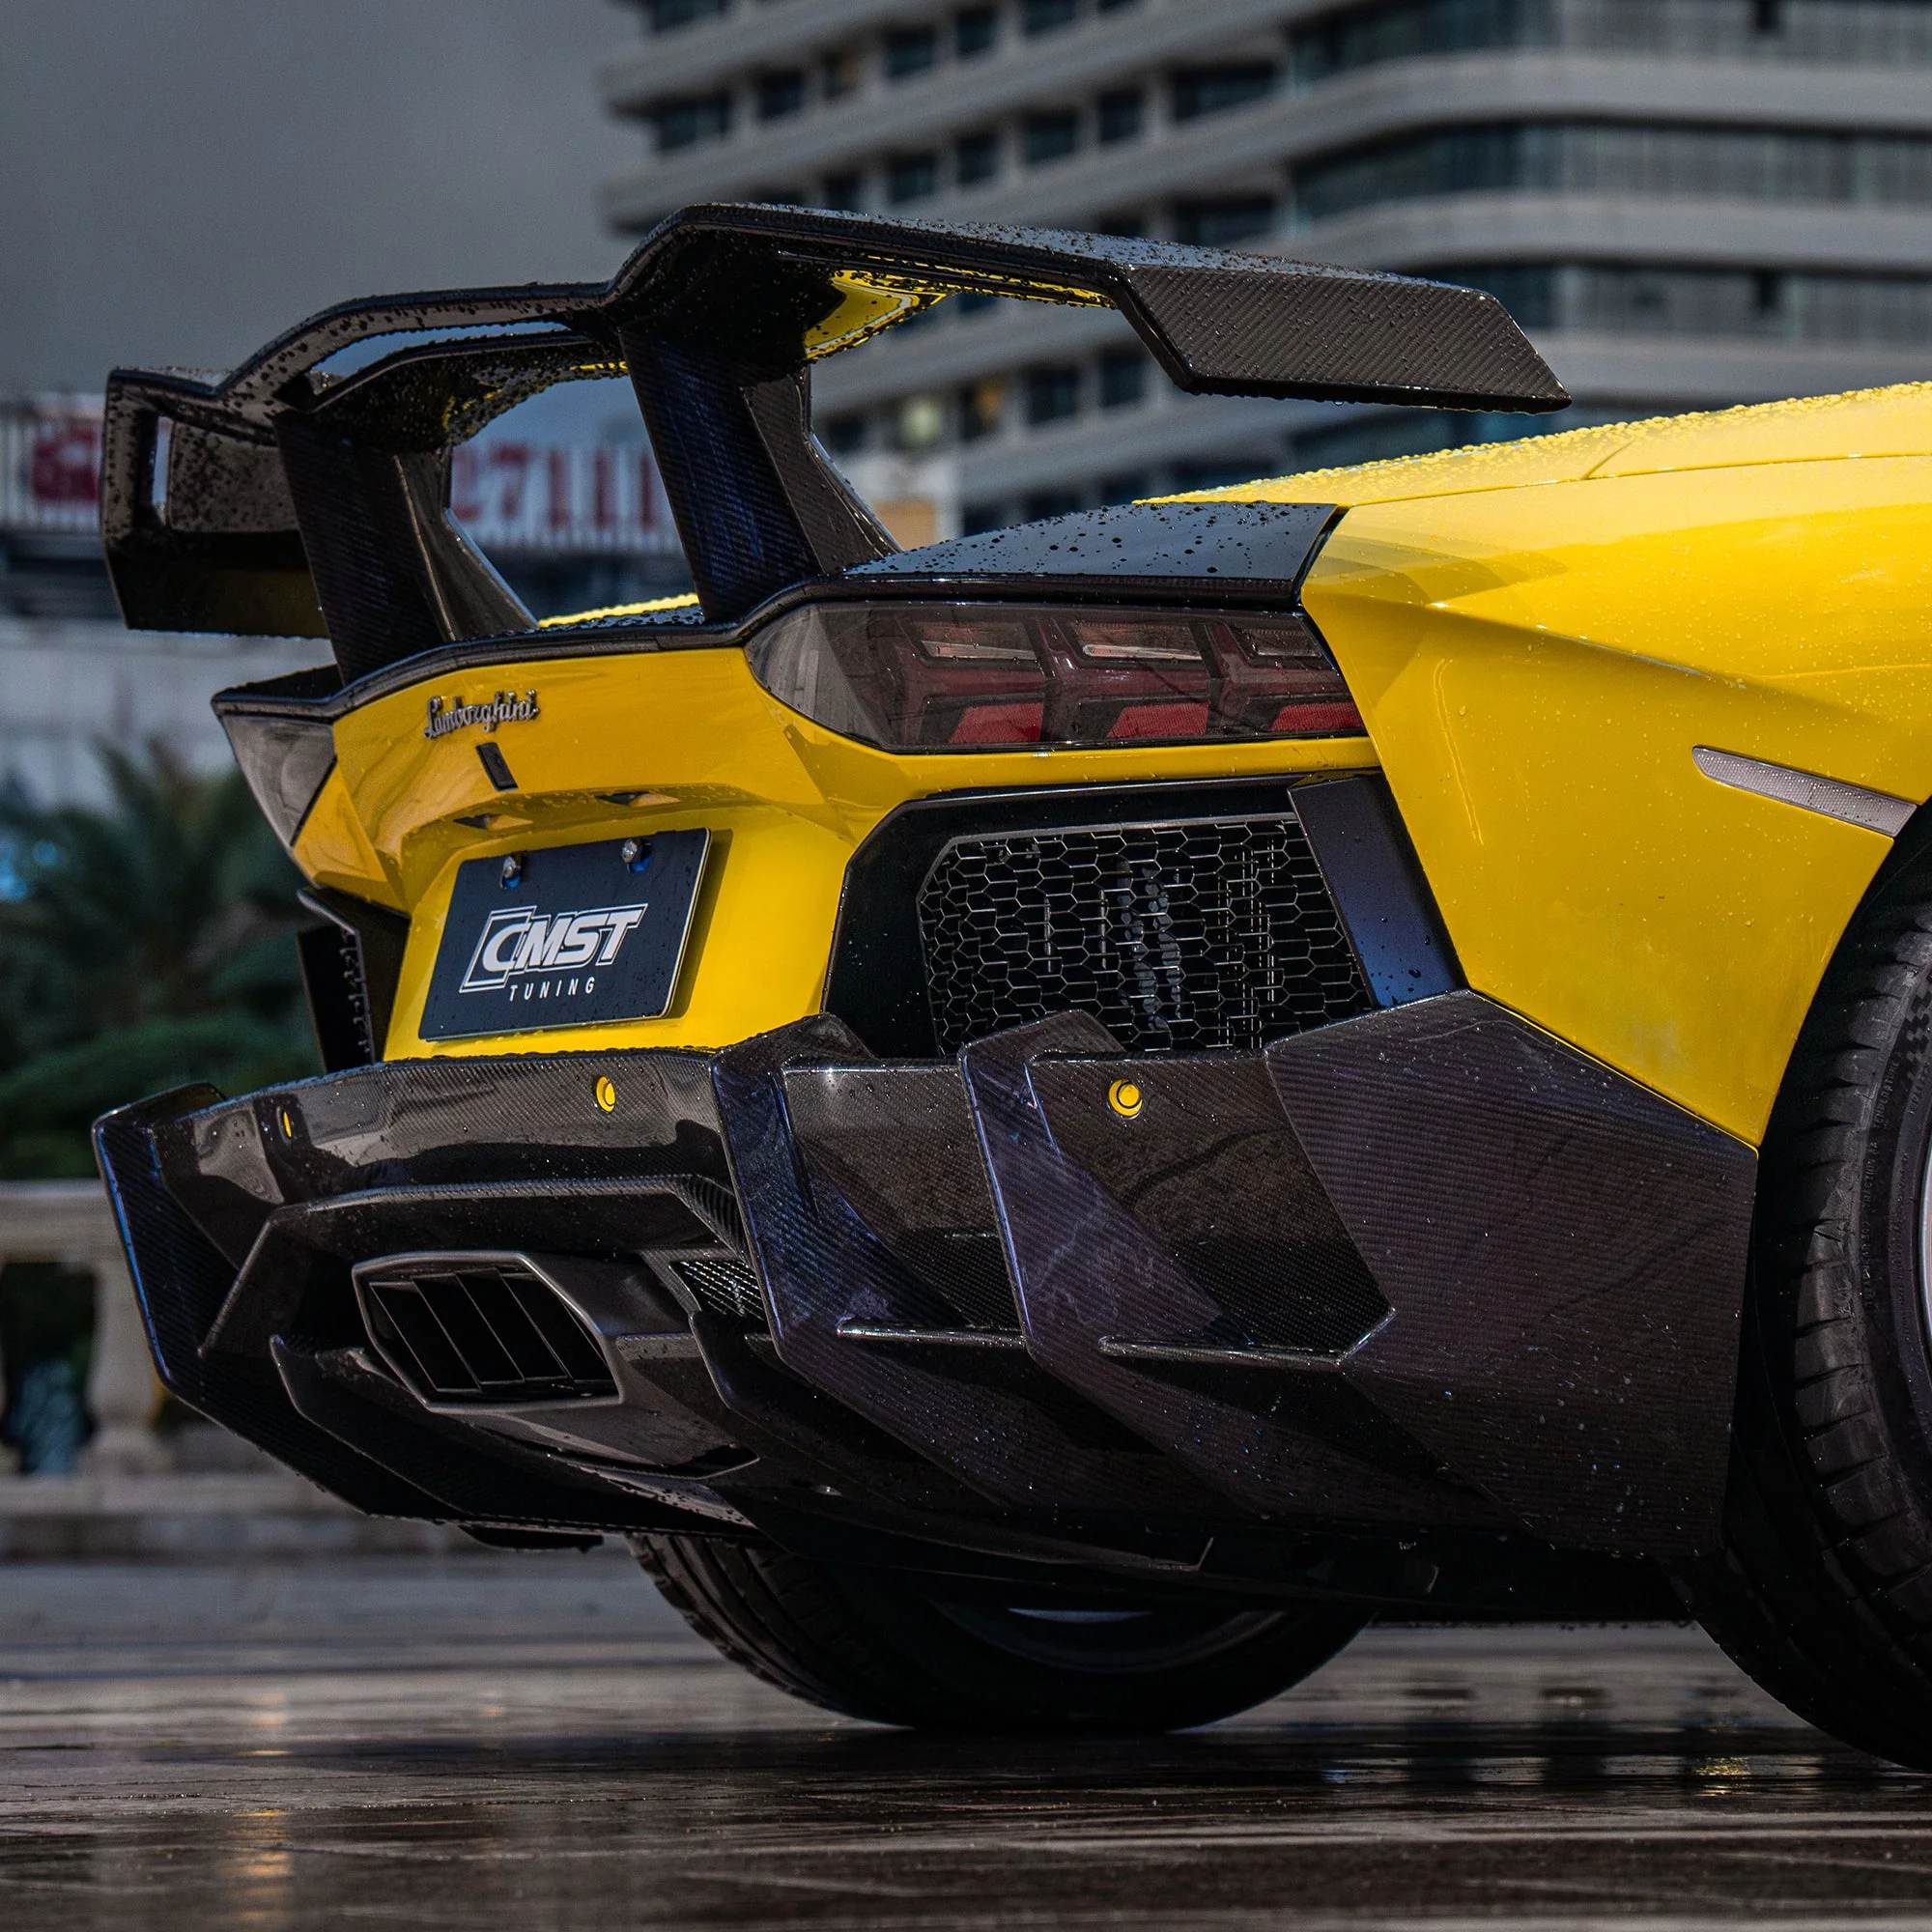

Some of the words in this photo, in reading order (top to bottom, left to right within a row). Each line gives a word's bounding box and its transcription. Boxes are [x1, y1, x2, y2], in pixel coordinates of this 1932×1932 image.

[423, 690, 539, 738] Lamborghini
[479, 906, 647, 976] CMST
[508, 977, 596, 1002] TUNING
[1872, 1060, 1899, 1128] TEMPERATURE
